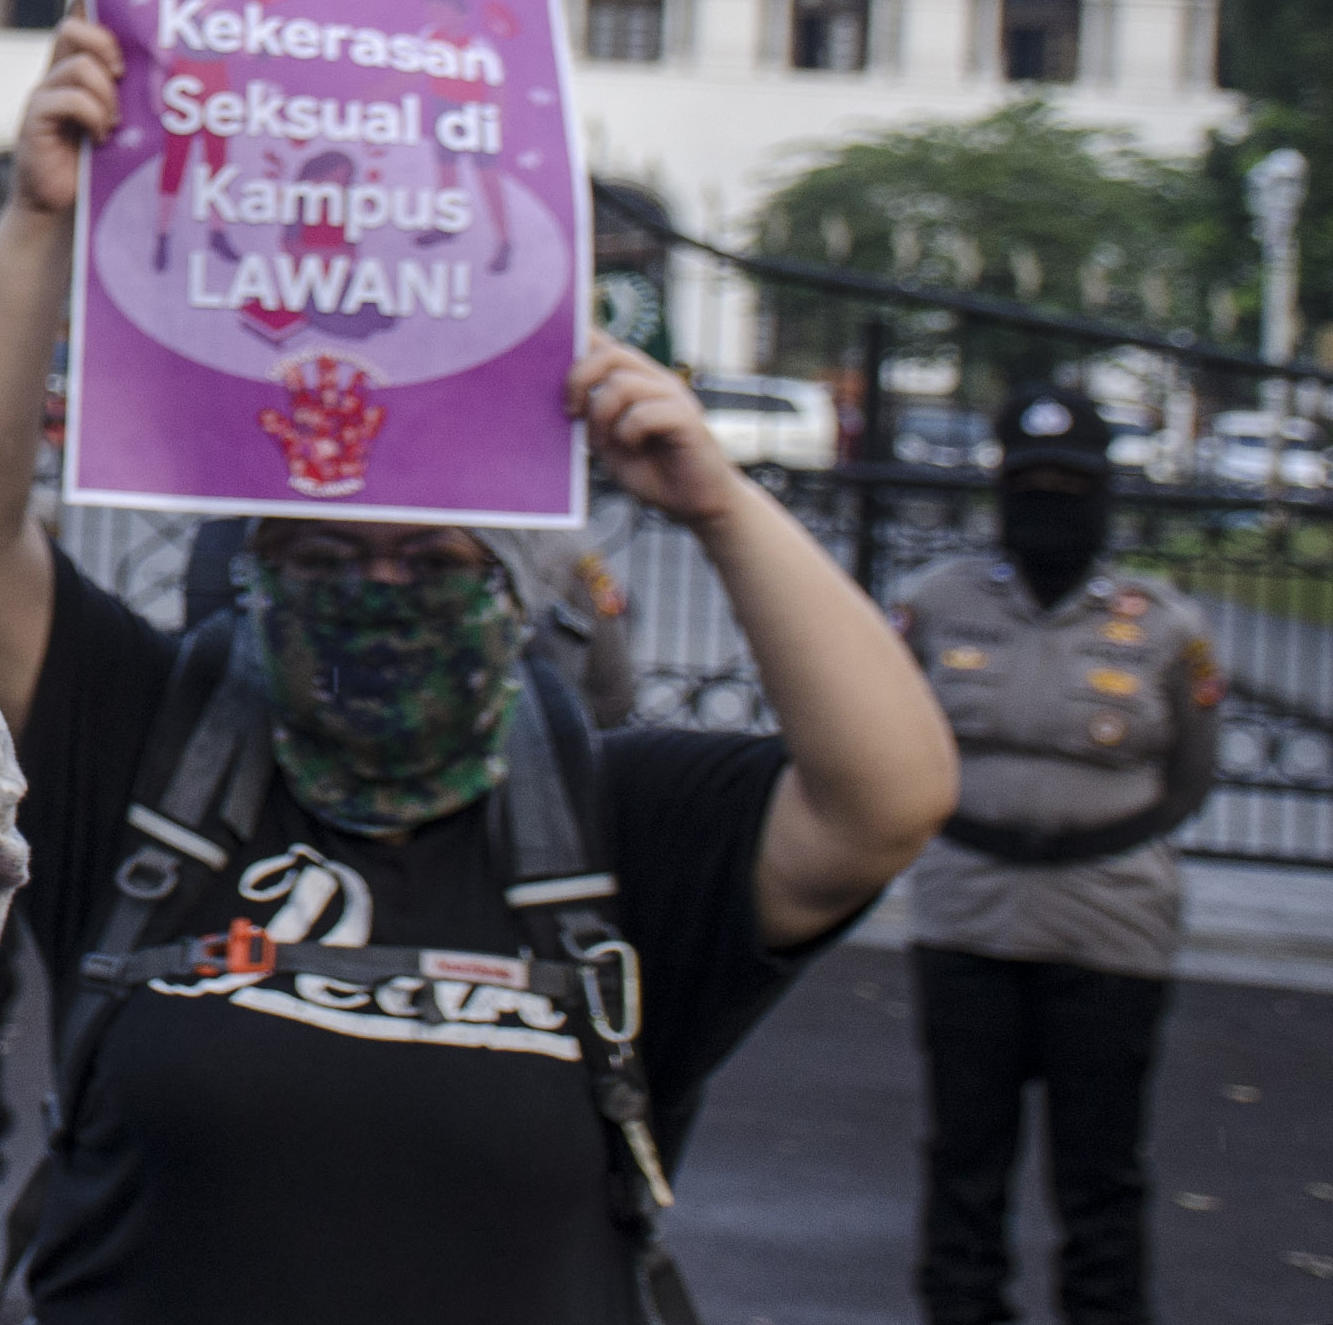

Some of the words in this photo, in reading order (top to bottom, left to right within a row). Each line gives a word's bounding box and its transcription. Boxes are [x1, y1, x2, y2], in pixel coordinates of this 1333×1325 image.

[161, 77, 417, 146] Seksual
[436, 102, 501, 153] di
[192, 165, 471, 243] Kampus
[186, 253, 471, 318] LAWAN!
